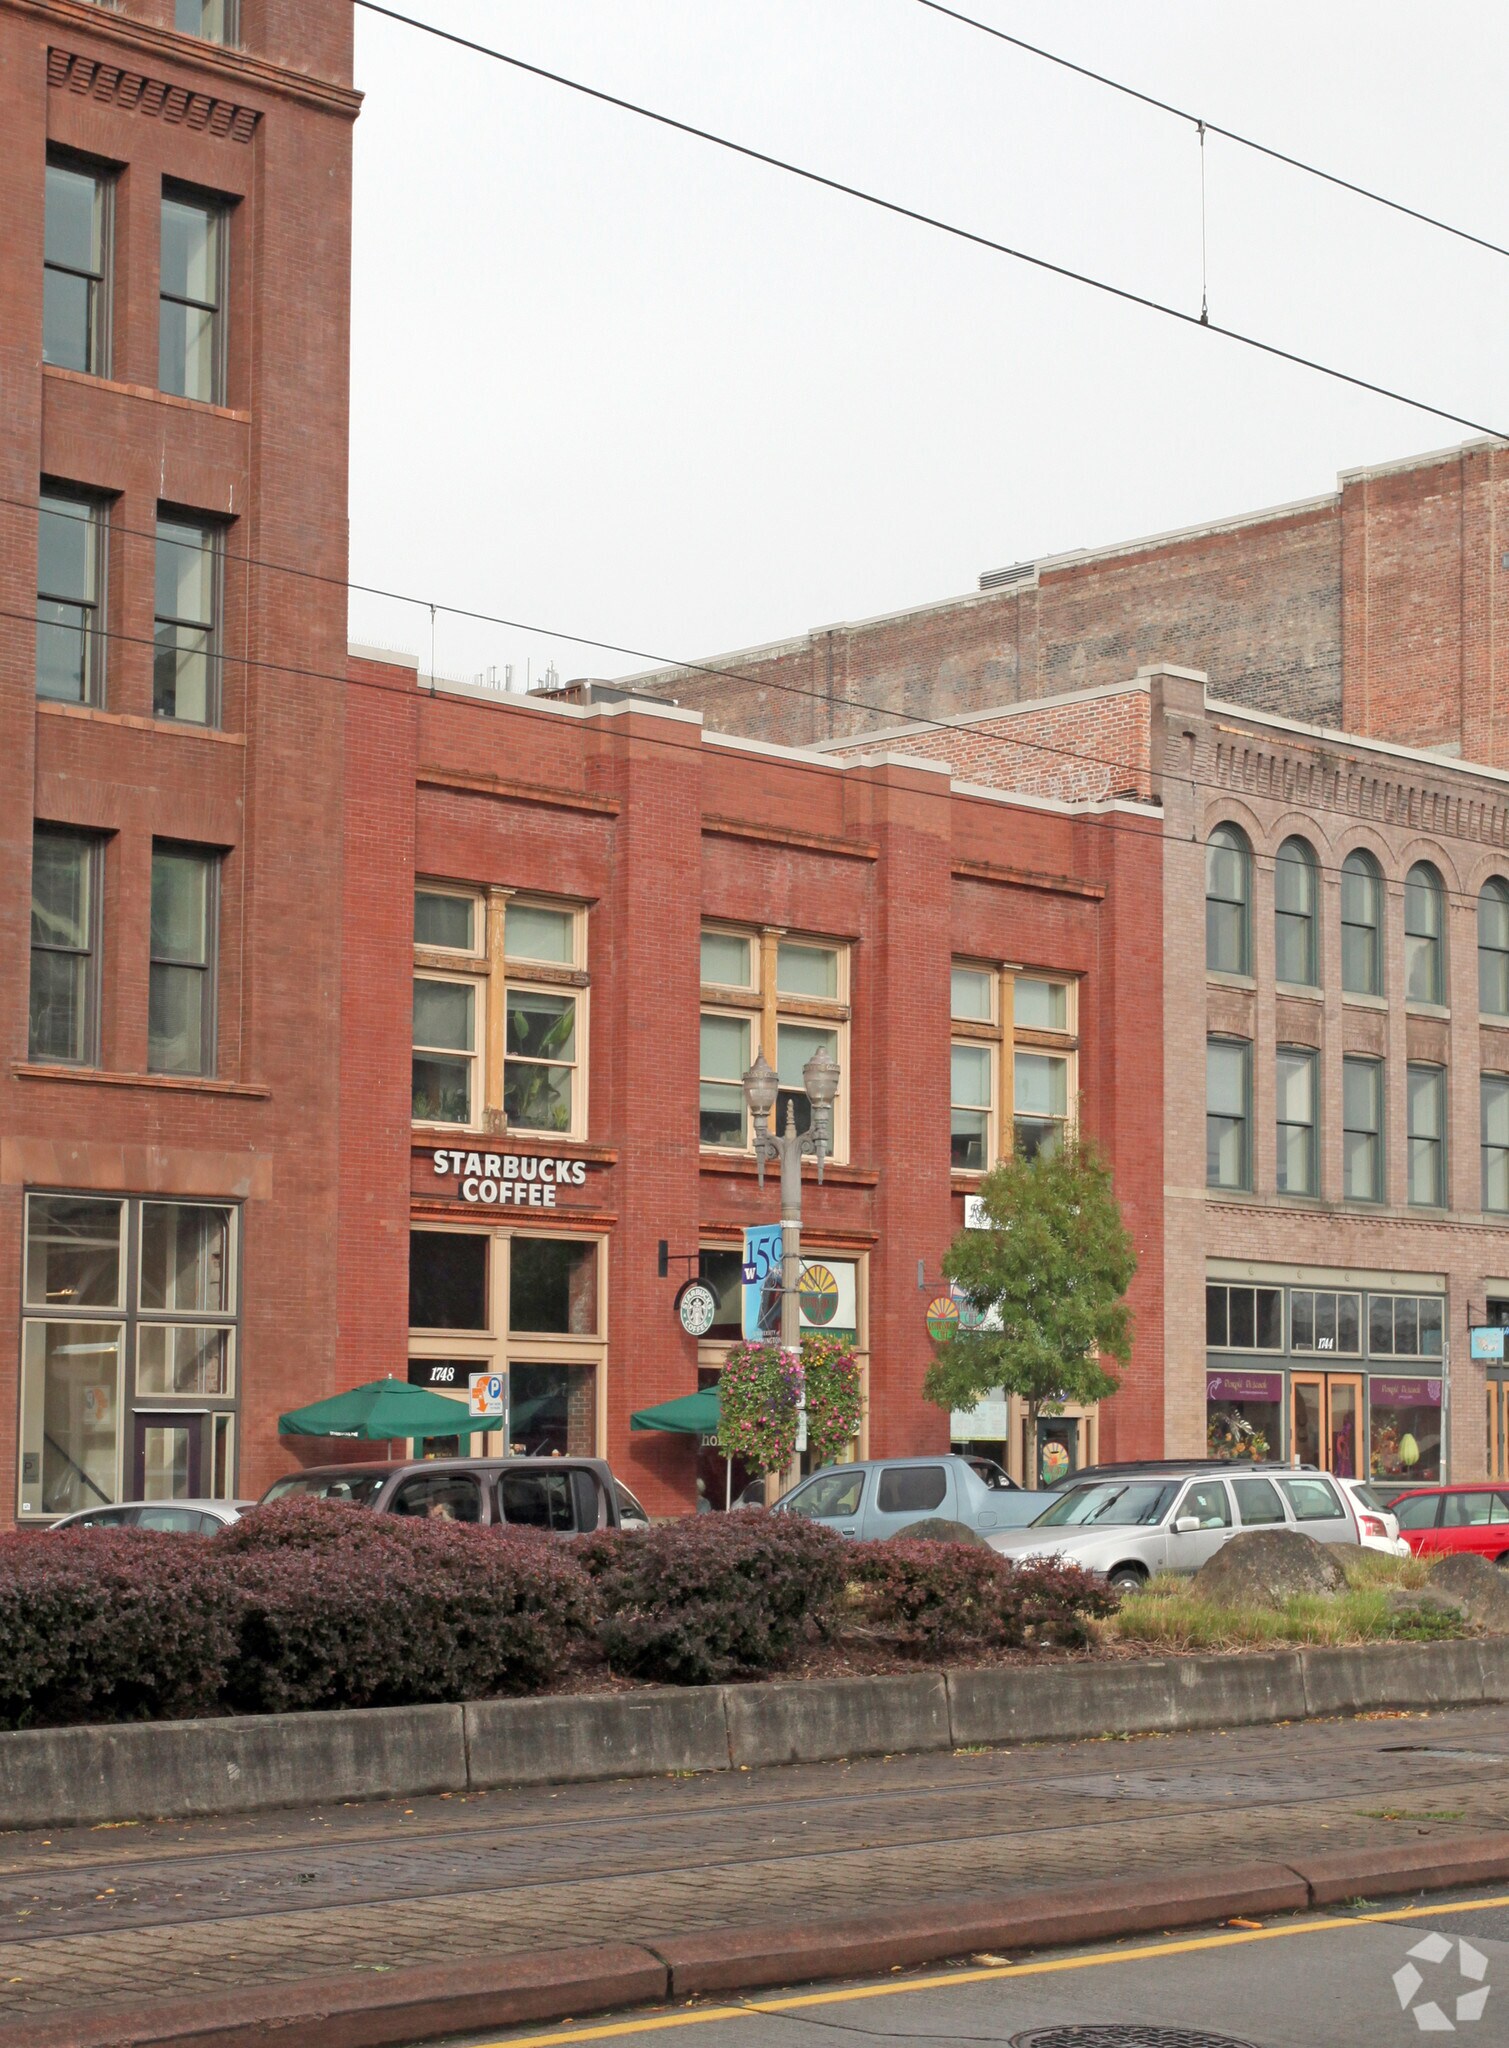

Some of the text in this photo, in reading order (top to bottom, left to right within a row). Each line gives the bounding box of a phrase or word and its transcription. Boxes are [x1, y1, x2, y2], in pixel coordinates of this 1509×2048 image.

[433, 1150, 586, 1184] STARBUCKS
[462, 1178, 556, 1207] COFFEE
[747, 1236, 782, 1280] 150
[744, 1267, 757, 1280] W
[682, 1288, 713, 1309] STARBUCKS
[684, 1320, 709, 1333] COFFEE
[1318, 1338, 1334, 1349] 1744
[430, 1367, 455, 1381] 1748
